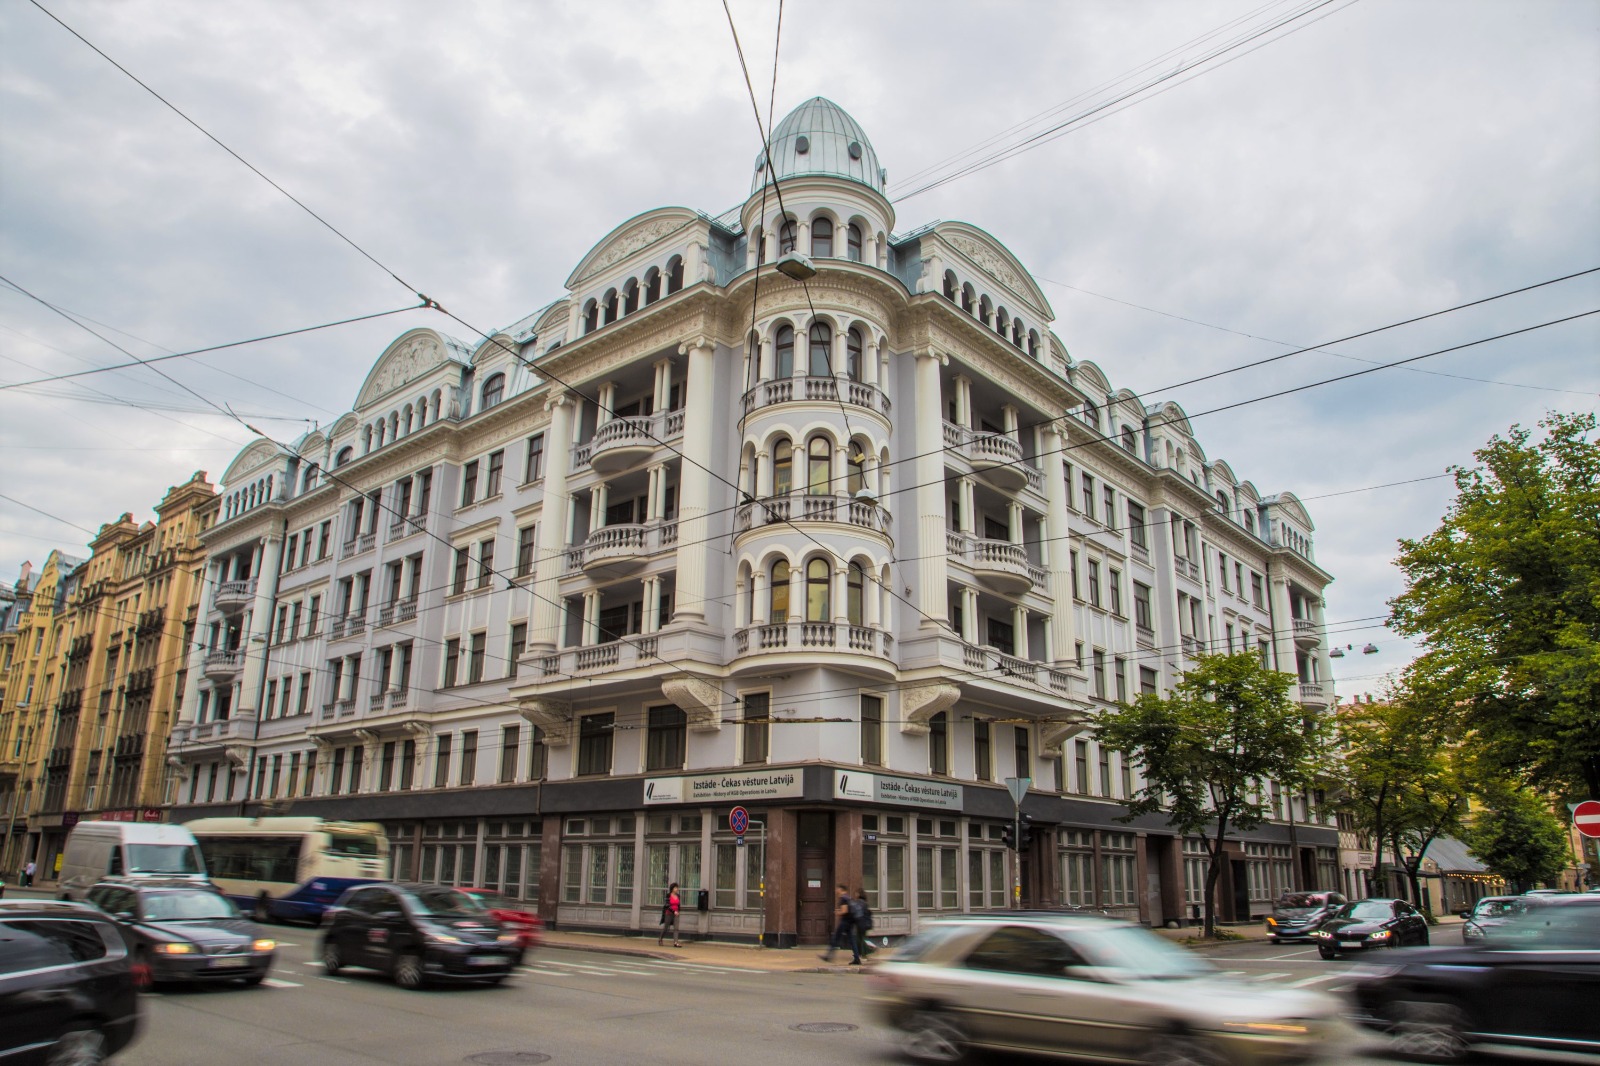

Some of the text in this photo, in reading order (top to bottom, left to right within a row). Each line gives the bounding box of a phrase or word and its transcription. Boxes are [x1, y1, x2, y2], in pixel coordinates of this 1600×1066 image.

[693, 780, 717, 790] Izstāde
[721, 777, 741, 788] Čekas
[742, 777, 768, 786] vēsture
[770, 774, 794, 786] Latvijā
